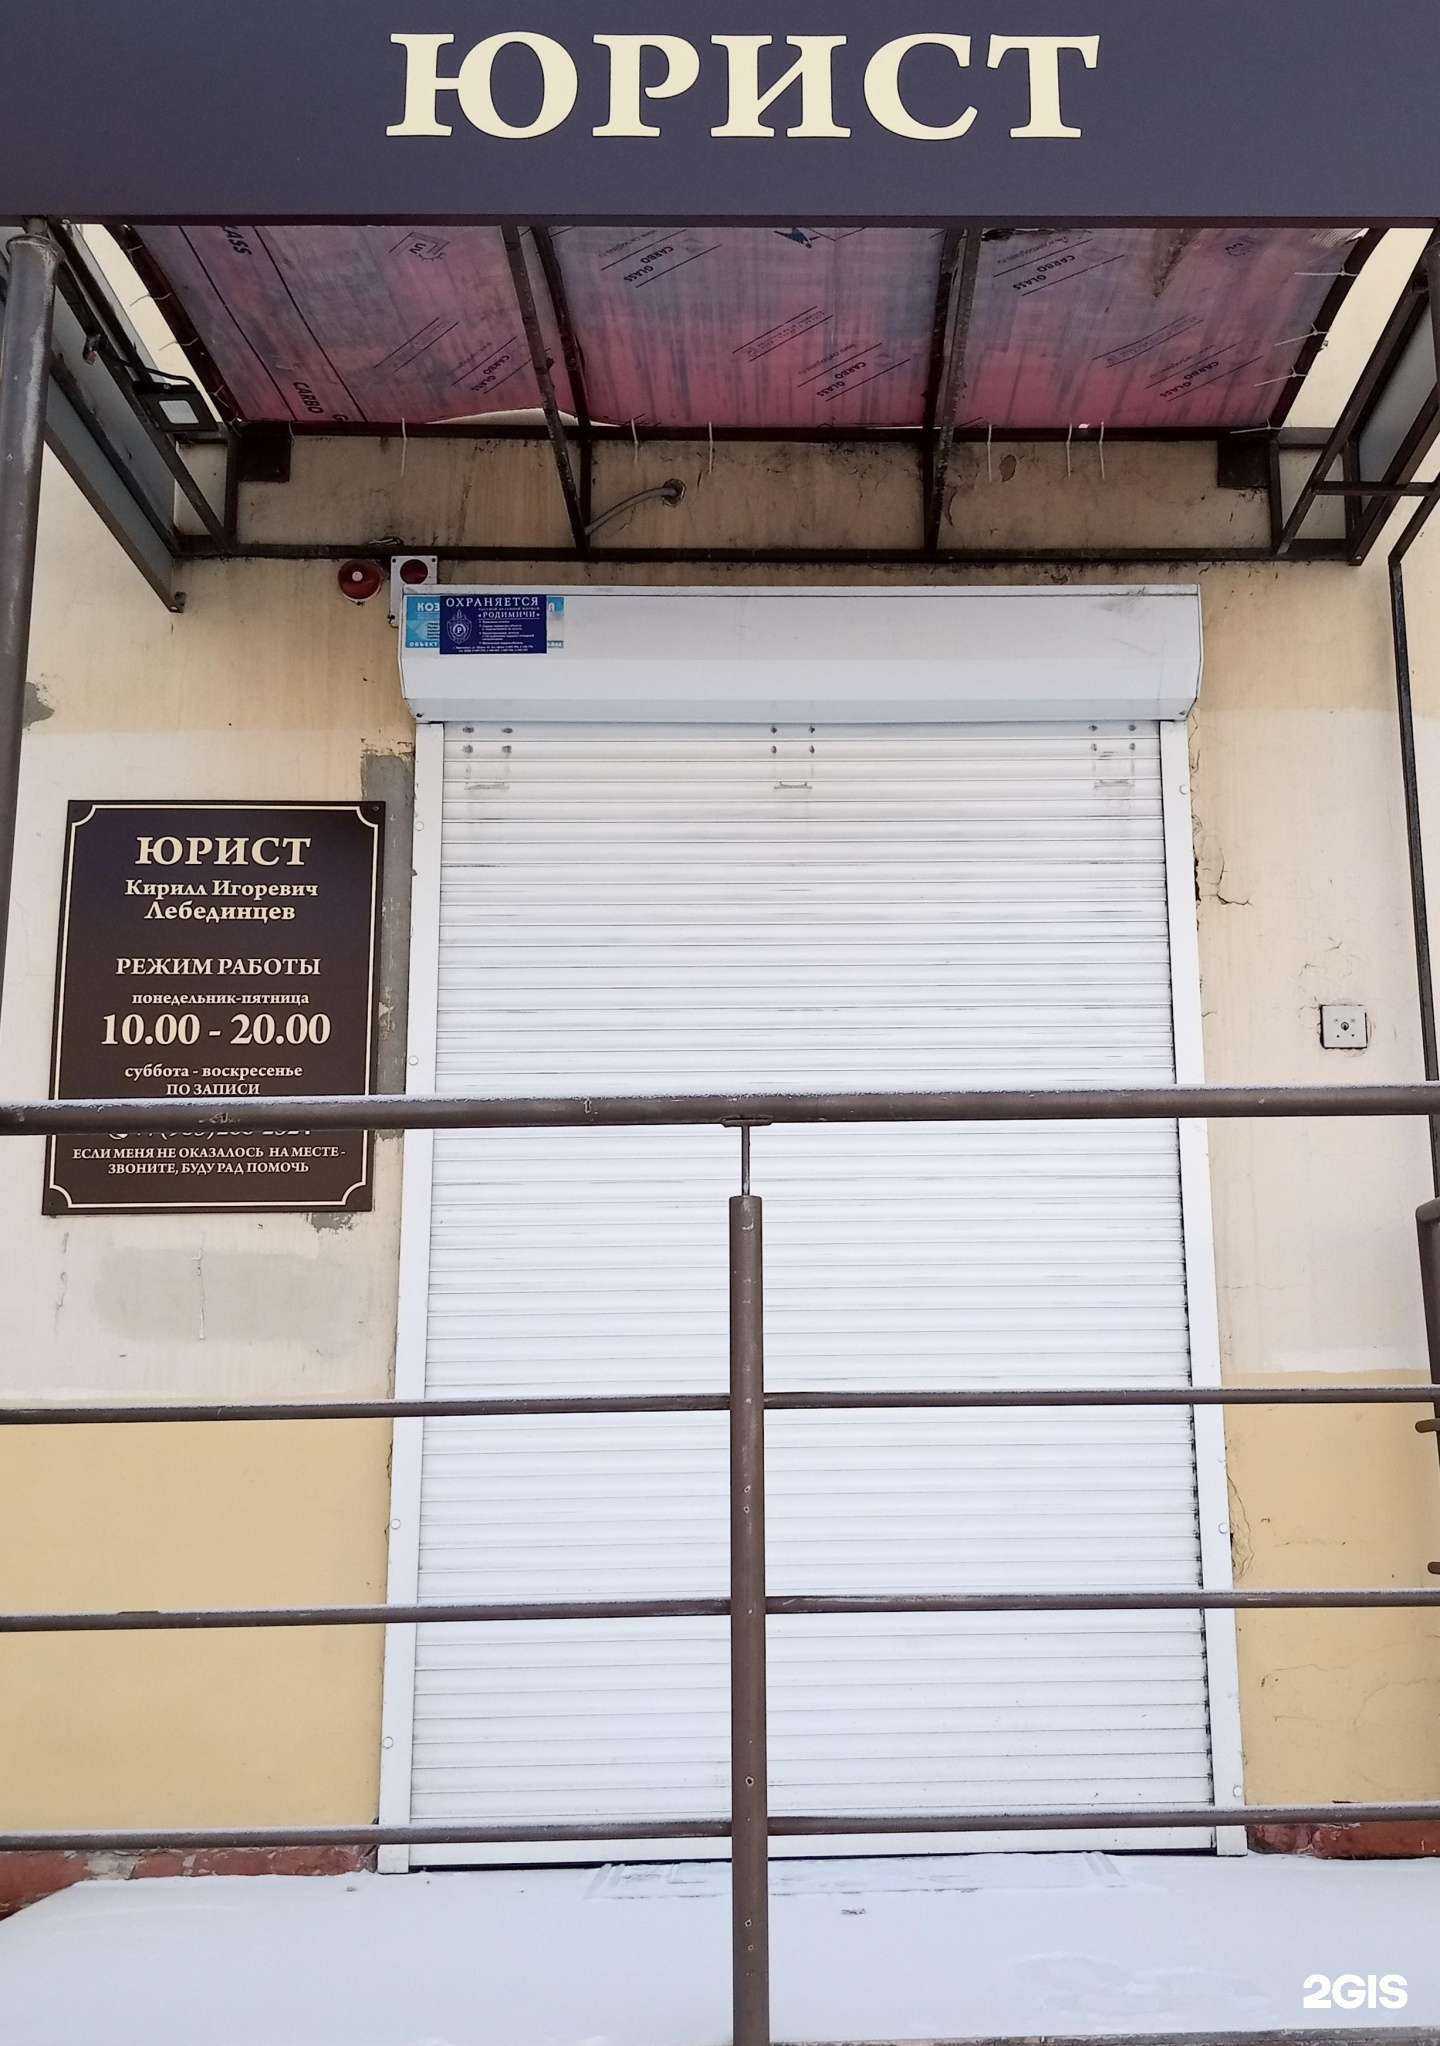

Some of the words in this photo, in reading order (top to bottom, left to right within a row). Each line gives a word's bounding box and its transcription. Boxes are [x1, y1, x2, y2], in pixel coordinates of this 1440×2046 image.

[386, 31, 1100, 140] ЮРИСТ
[640, 246, 674, 264] CARBO
[1036, 255, 1076, 272] CARBO
[624, 265, 654, 283] GLASS
[1012, 274, 1047, 290] GLASS
[293, 381, 325, 414] CARBO
[416, 602, 440, 612] КОЗ
[446, 596, 539, 608] ОХРАНЯЕТСЯ
[134, 836, 312, 866] ЮРИСТ
[125, 879, 209, 900] Кирилл
[212, 879, 319, 900] Игоревич
[144, 901, 296, 923] Лебединцев
[115, 958, 214, 975] РЕЖИМ
[217, 958, 321, 975] РАБОТЫ
[131, 992, 310, 1006] понедельник-пятница
[101, 1013, 201, 1045] 10.00
[230, 1013, 331, 1045] 20.00
[124, 1063, 190, 1081] суббота
[202, 1066, 303, 1078] воскресенье
[166, 1083, 191, 1095] ПО
[194, 1083, 261, 1095] ЗАПИСИ
[72, 1148, 111, 1159] ЕСЛИ
[112, 1147, 154, 1159] МЕНЯ
[156, 1147, 177, 1158] НЕ
[178, 1147, 264, 1158] ОКАЗАЛОСЬ
[268, 1146, 290, 1158] НА
[108, 1163, 179, 1176] ЗВОНИТЕ,
[181, 1162, 216, 1175] БУДУ
[216, 1162, 245, 1175] РАД
[246, 1161, 309, 1173] ПОМОЧЬ
